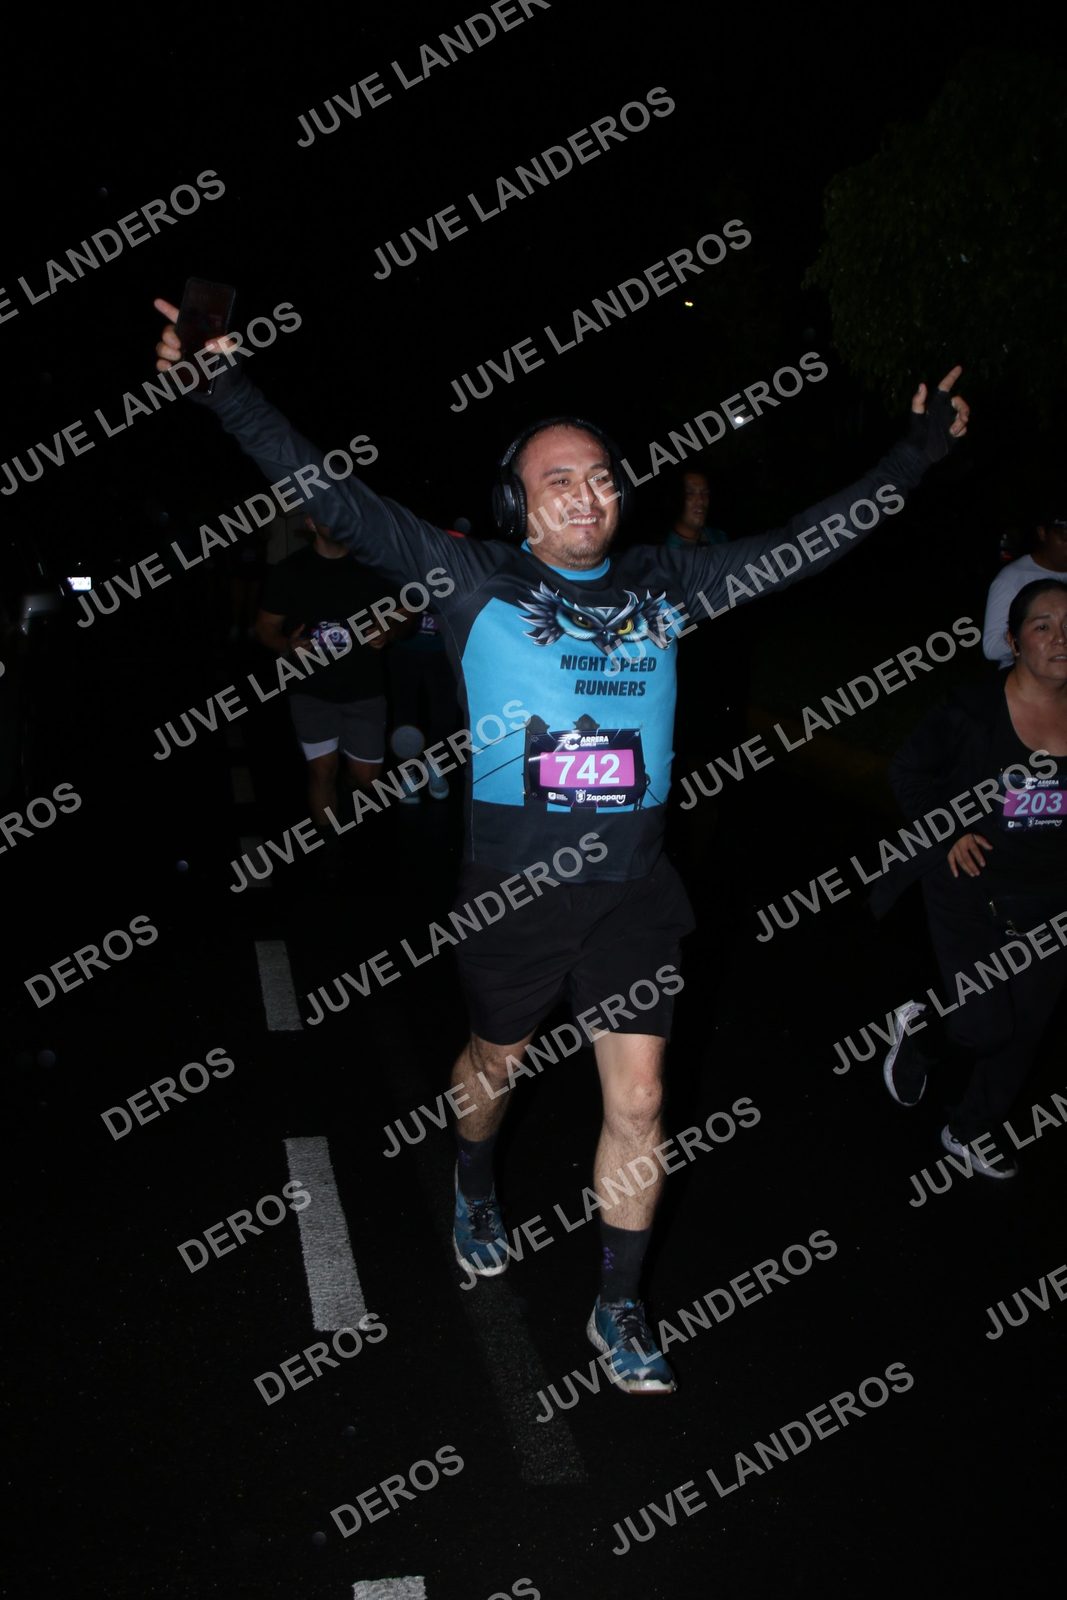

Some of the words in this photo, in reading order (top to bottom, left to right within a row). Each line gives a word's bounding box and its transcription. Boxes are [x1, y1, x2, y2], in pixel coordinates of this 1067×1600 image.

[560, 655, 607, 671] NIGHT
[610, 656, 656, 672] SPEED
[574, 679, 646, 696] RUNNERS
[555, 753, 620, 785] 742
[1014, 792, 1063, 815] 203
